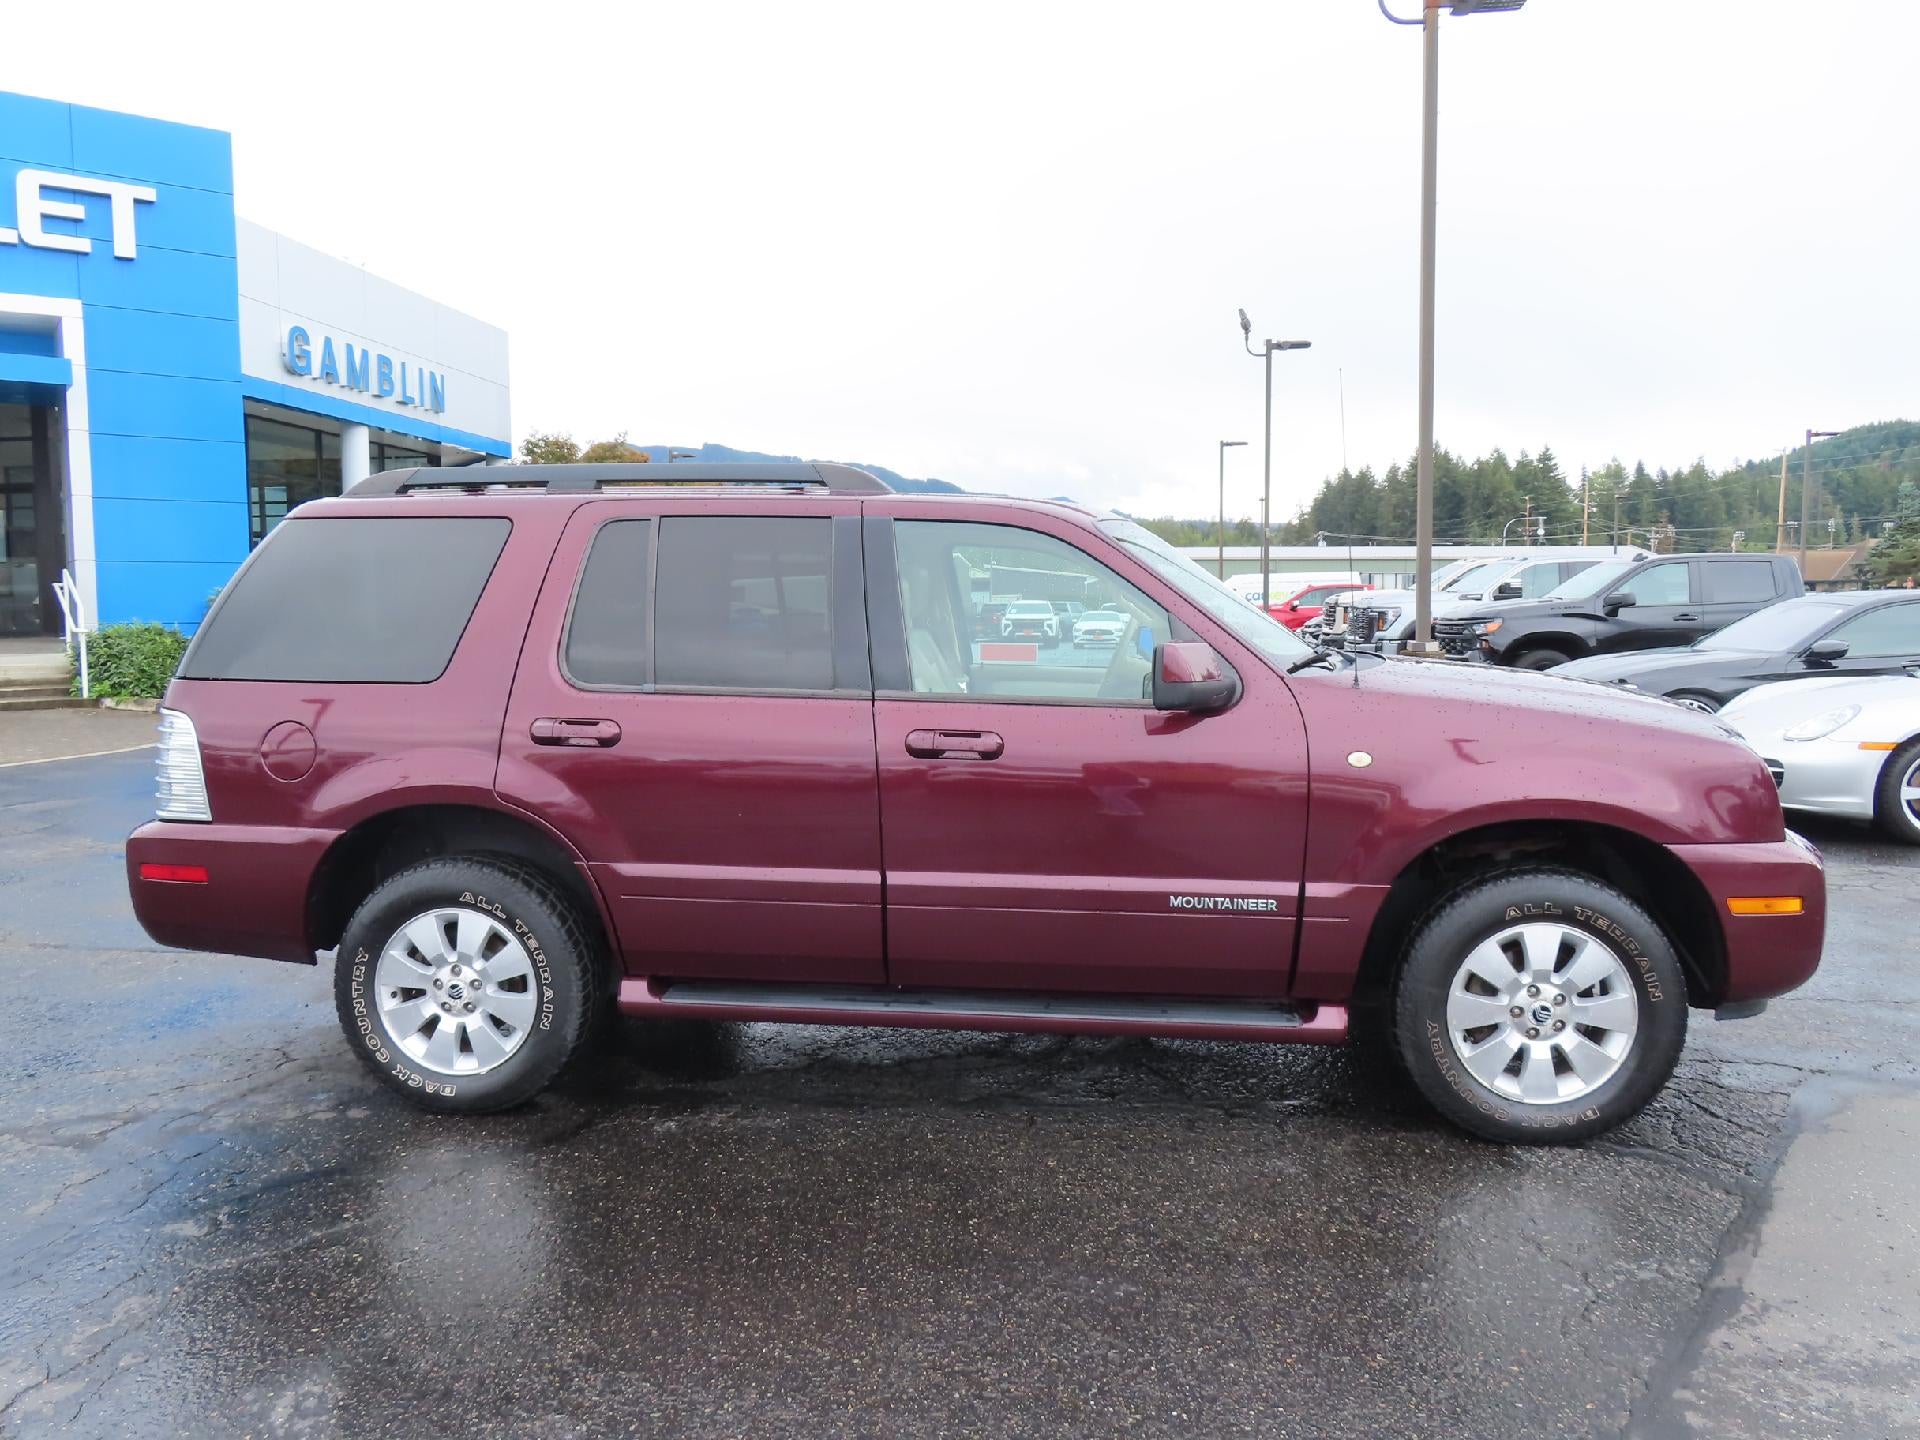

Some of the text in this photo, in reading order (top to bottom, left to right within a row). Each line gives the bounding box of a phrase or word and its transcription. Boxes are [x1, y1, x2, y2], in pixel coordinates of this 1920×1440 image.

[283, 325, 445, 413] GAMBLIN
[1169, 895, 1278, 911] MOUNTAINEER
[1505, 902, 1664, 1002] ALL TERRAIN
[459, 891, 554, 1030] ALL TERRAIN
[352, 947, 456, 1096] BACK COUNTRY
